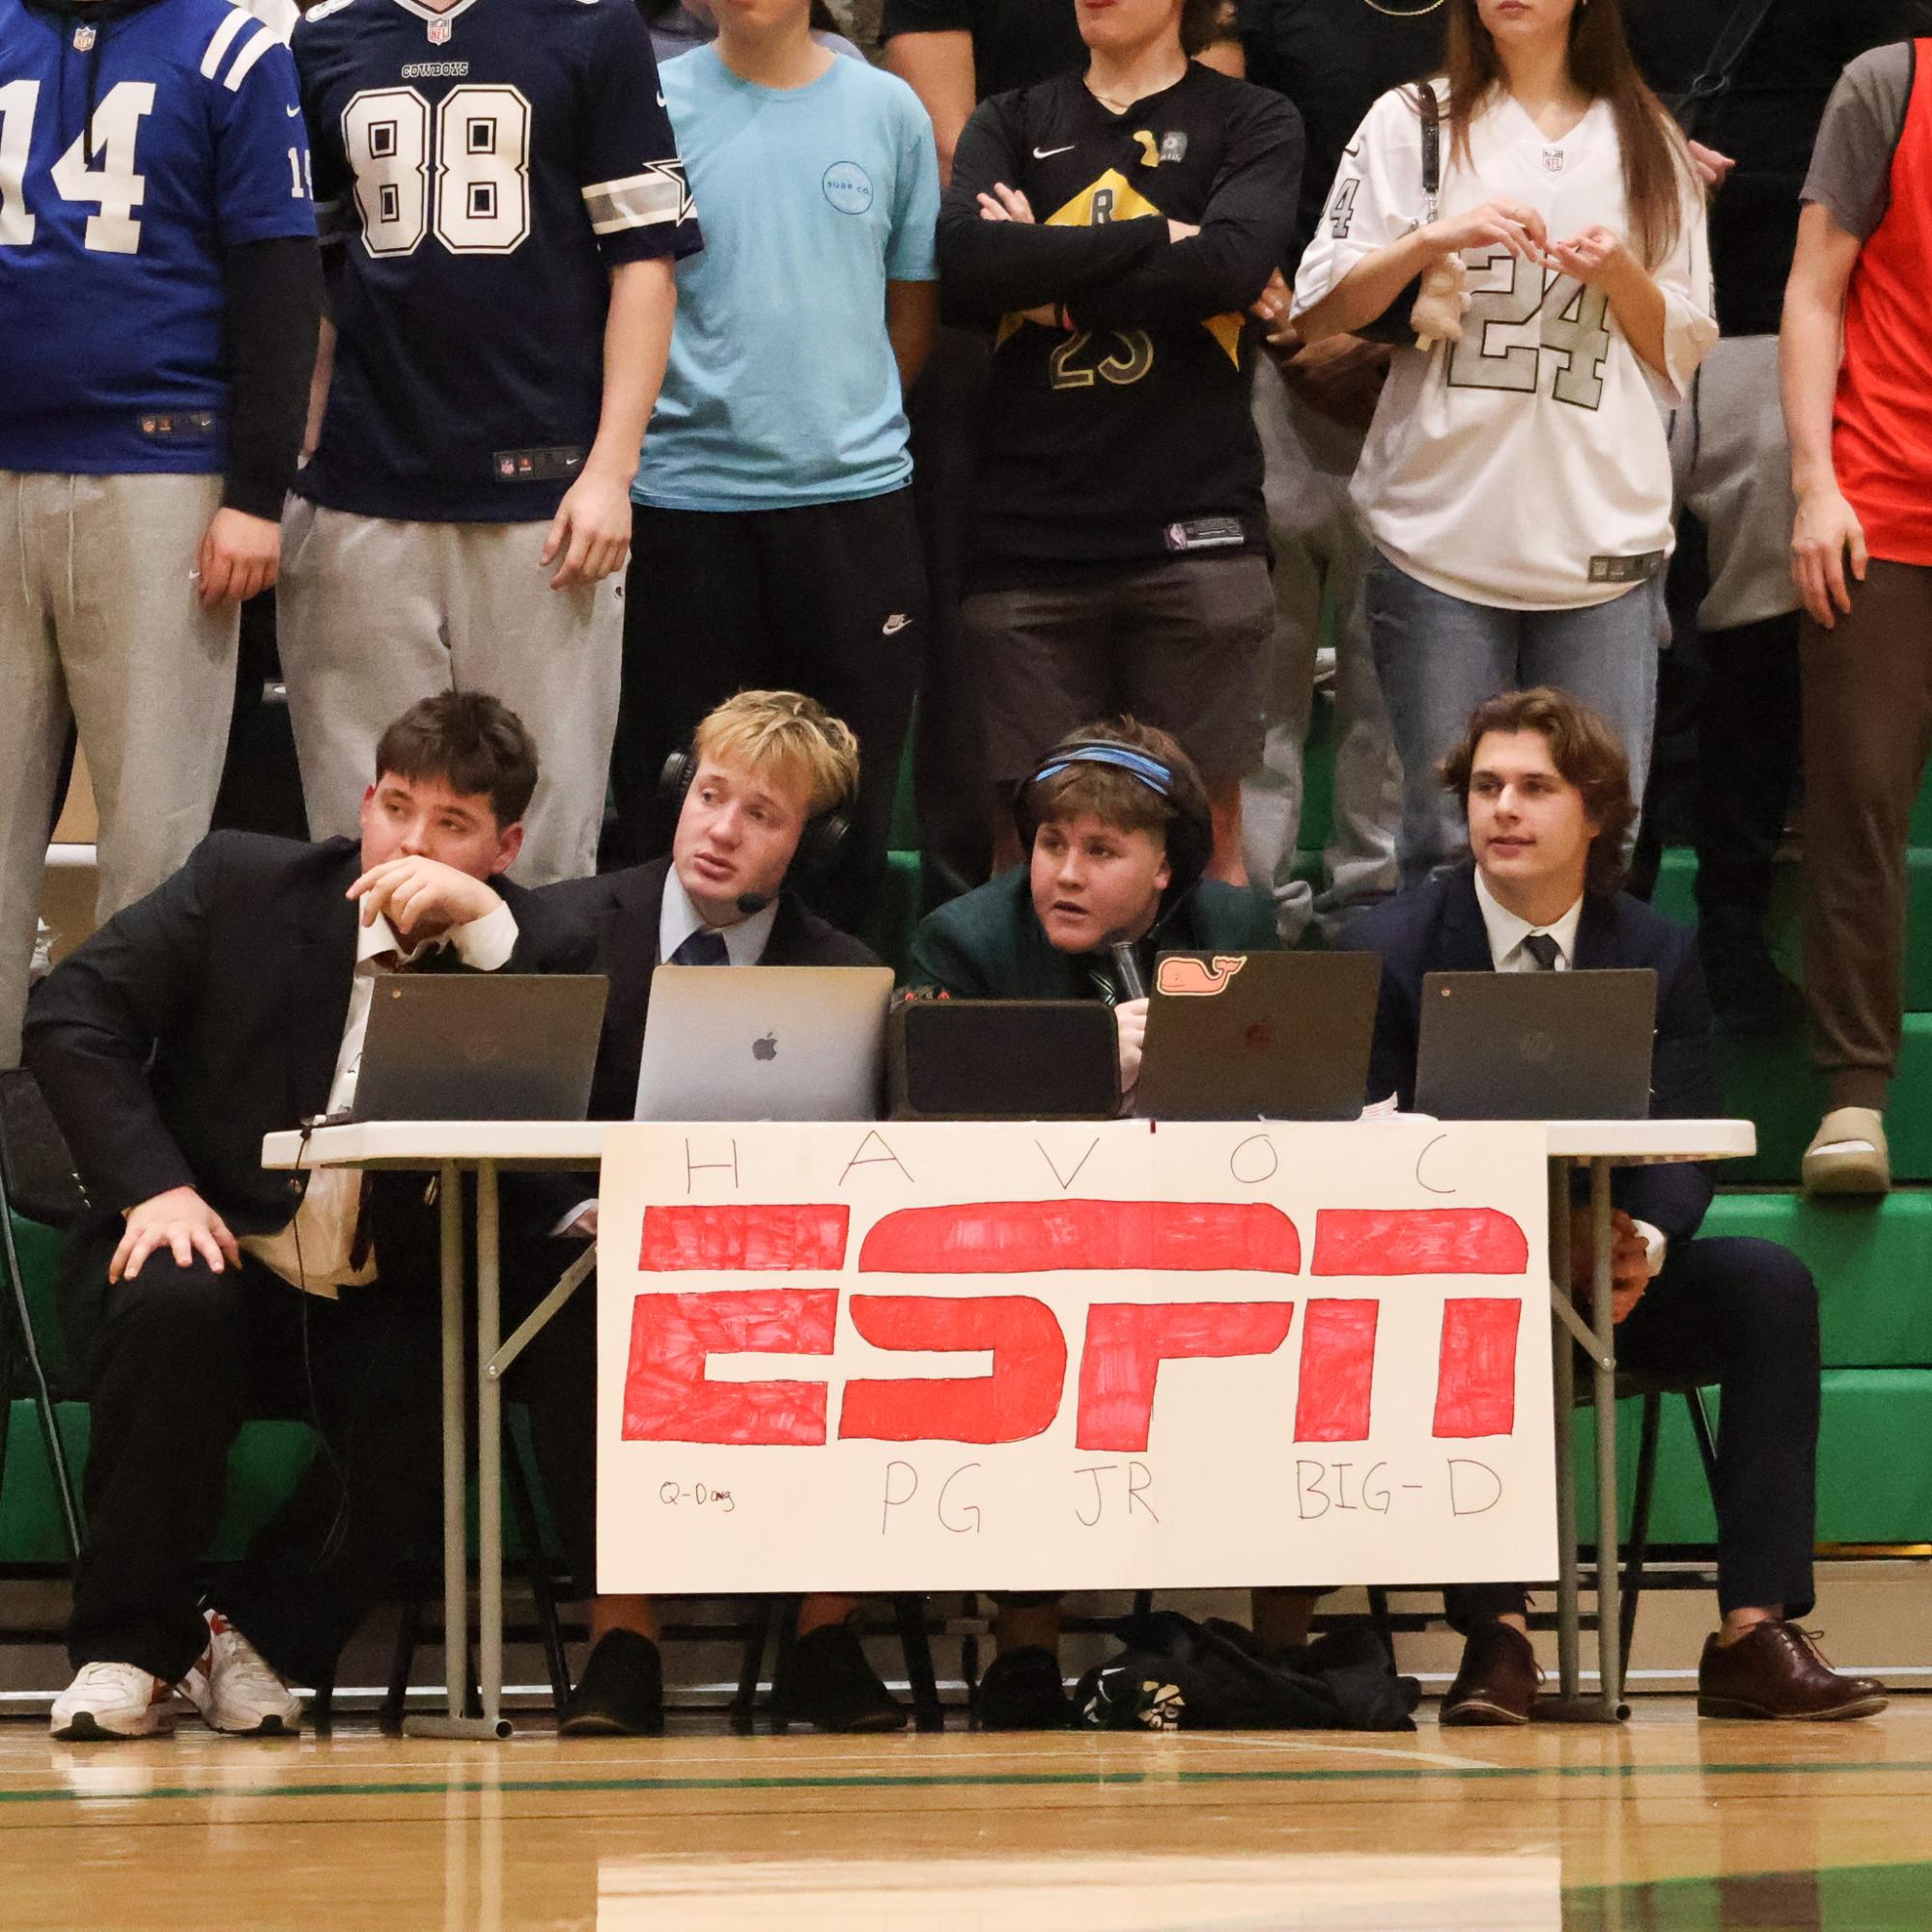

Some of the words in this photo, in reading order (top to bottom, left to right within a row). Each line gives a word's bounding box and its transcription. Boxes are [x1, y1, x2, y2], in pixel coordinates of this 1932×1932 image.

[402, 62, 469, 78] COWBOYS
[0, 79, 156, 255] 14
[341, 84, 532, 259] 88
[1446, 243, 1610, 410] 24
[621, 1198, 1529, 1453] ESPN
[882, 1460, 981, 1535] PG
[1074, 1461, 1160, 1526] JR
